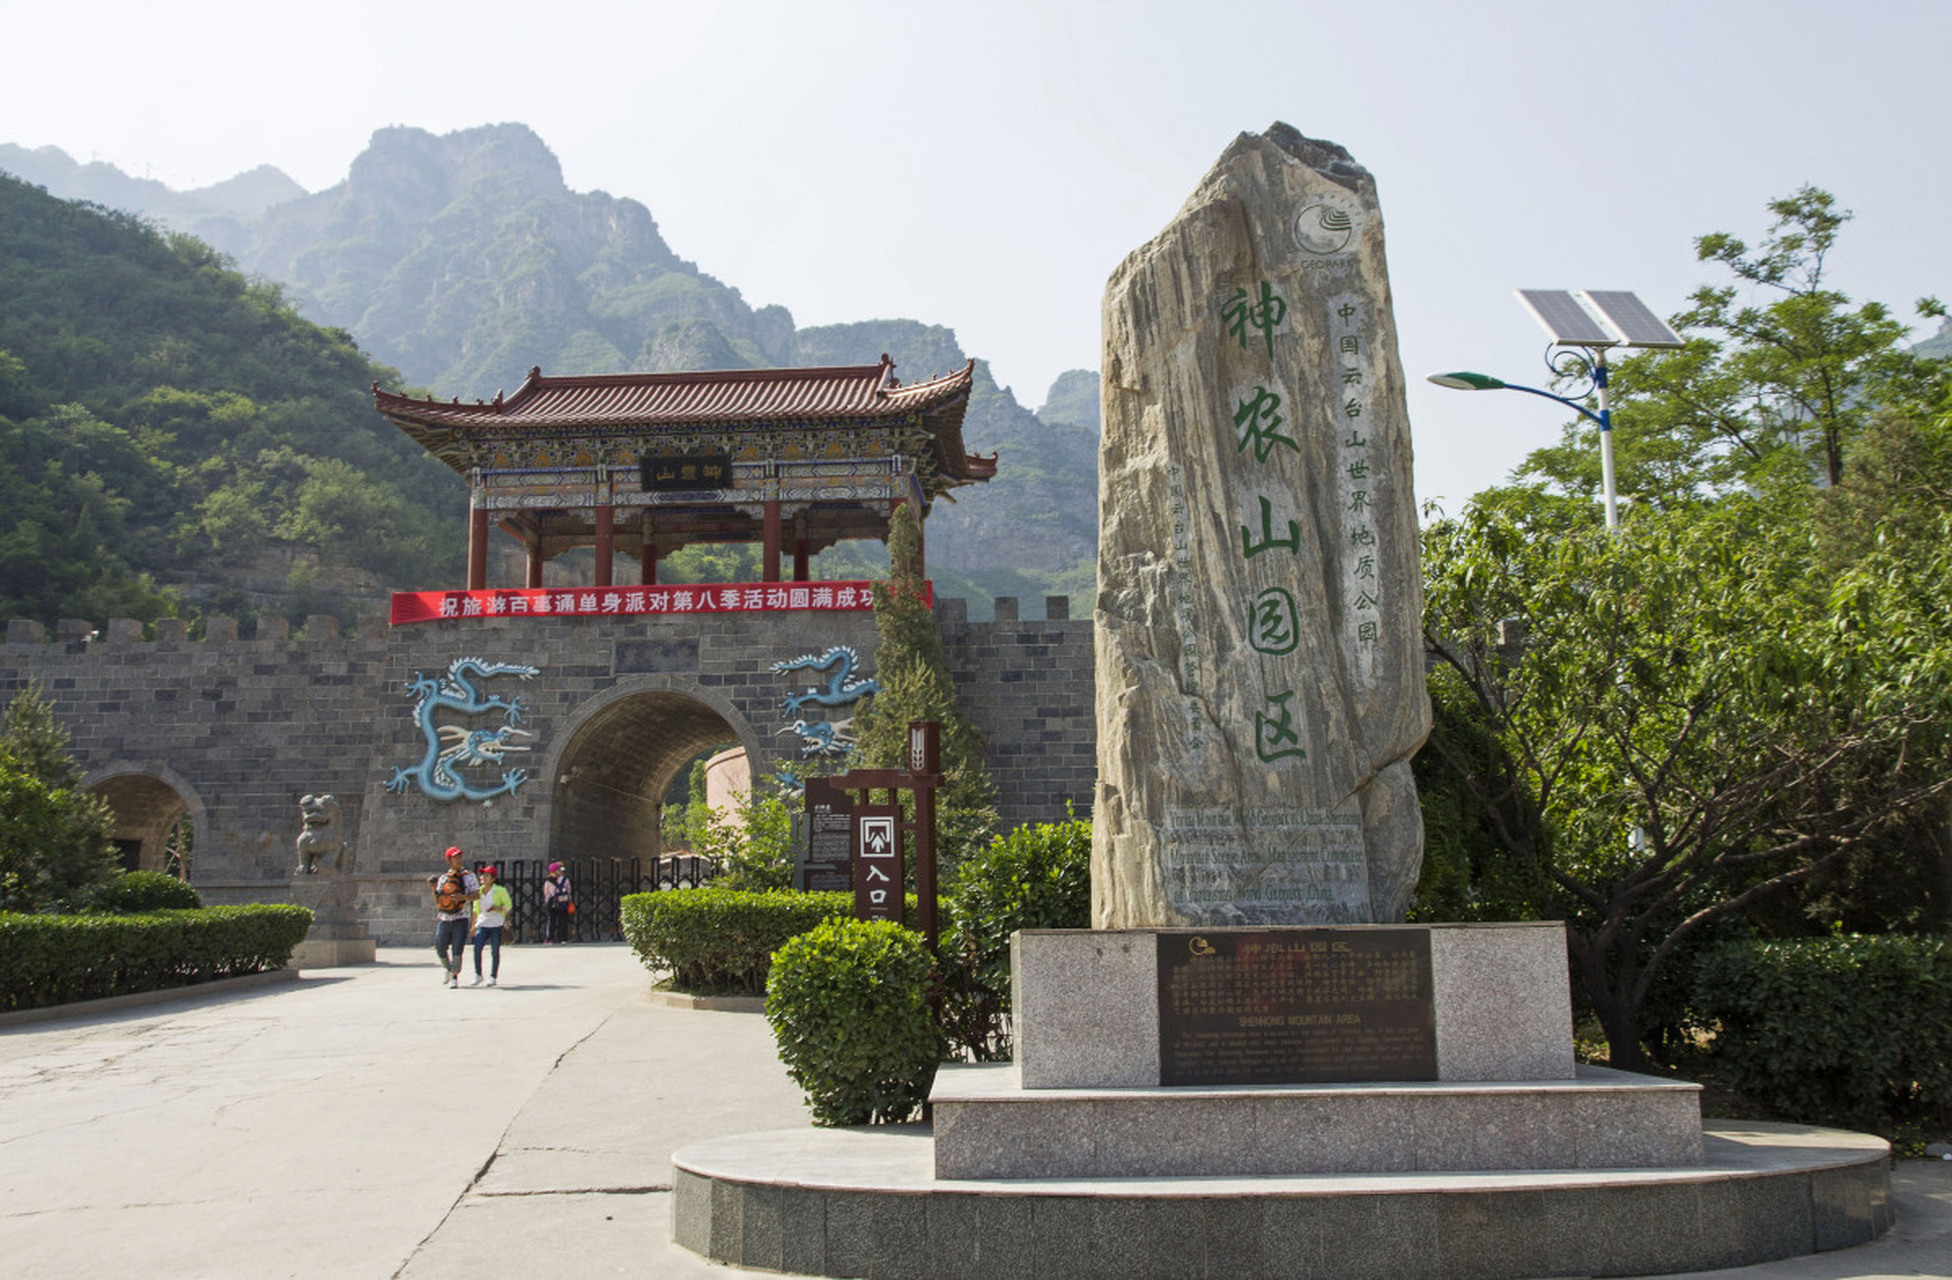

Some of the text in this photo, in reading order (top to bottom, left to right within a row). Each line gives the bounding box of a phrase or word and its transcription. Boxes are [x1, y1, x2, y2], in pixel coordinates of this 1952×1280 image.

[1220, 280, 1306, 763] 神农山园区
[1337, 302, 1378, 644] 中国云台山世界地质公园
[866, 864, 890, 903] 入口
[1336, 1013, 1361, 1025] AREA
